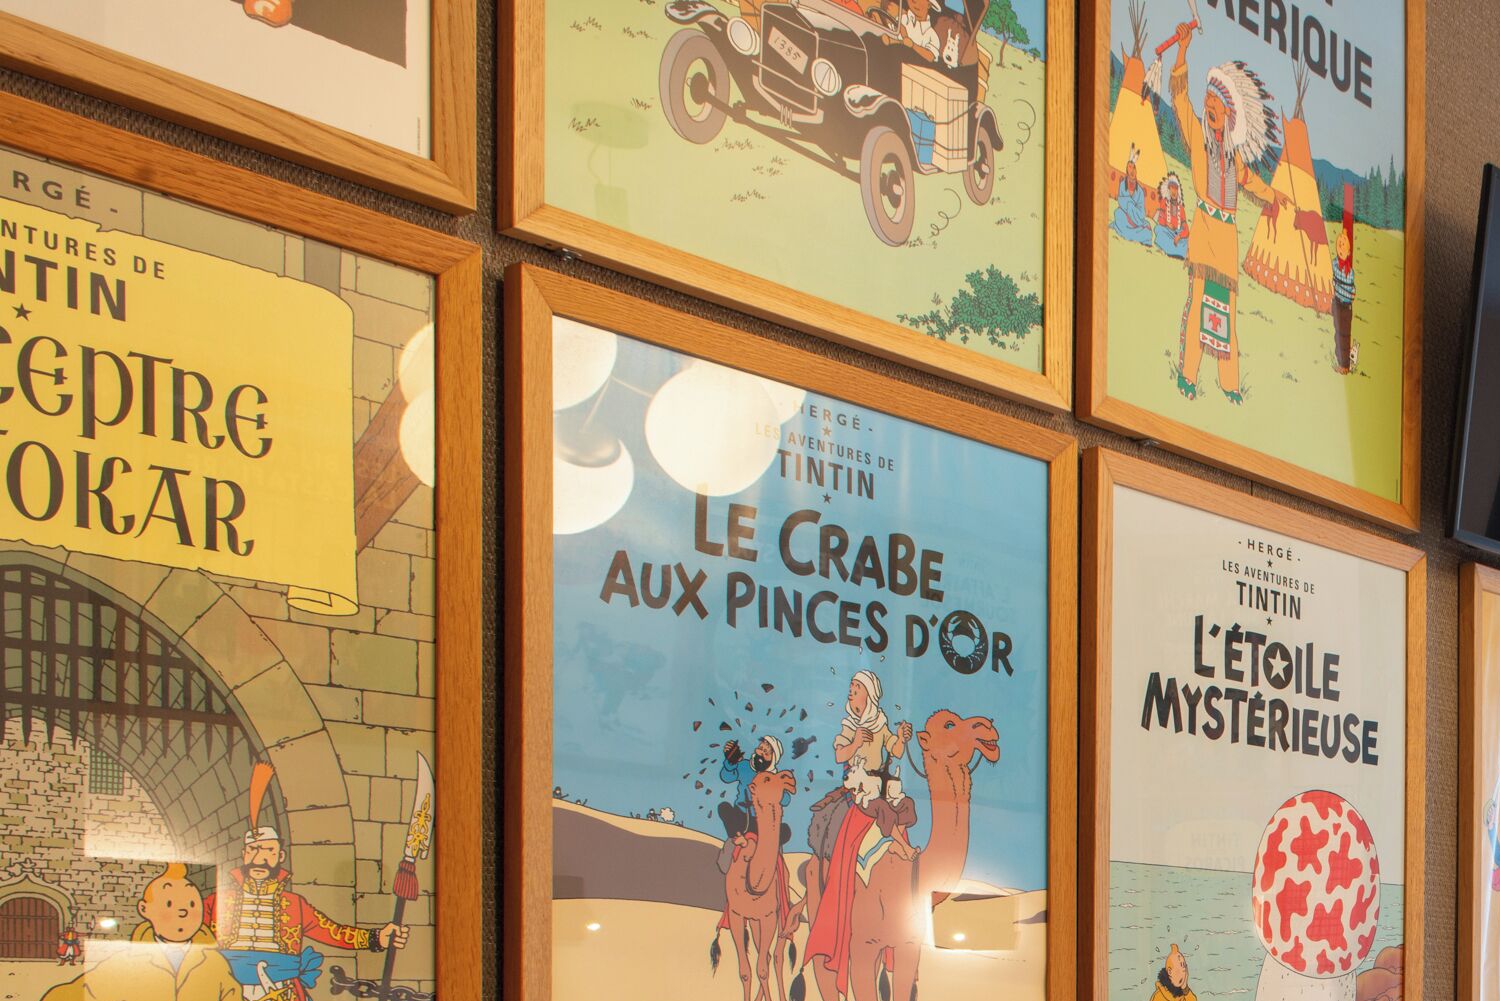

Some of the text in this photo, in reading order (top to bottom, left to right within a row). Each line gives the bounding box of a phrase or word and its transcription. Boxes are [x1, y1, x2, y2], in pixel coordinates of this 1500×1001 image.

[133, 254, 166, 280] DE
[0, 325, 272, 459] EPTRE
[777, 448, 875, 501] TINTIN
[787, 431, 872, 465] AVENTURES
[878, 455, 894, 471] DE
[0, 430, 255, 557] OKAR
[694, 482, 759, 562] LE
[778, 509, 945, 602] CRABE
[1222, 560, 1315, 594] LES AVENTURES DE
[1247, 538, 1293, 561] HERGÉ
[599, 550, 709, 621] AUX
[726, 571, 889, 653] PINCES
[906, 609, 1015, 677] D'OR
[1236, 580, 1301, 620] TINTIN
[1194, 614, 1340, 702] L'ÉTOILE
[1140, 671, 1379, 766] MYSTÉRIEUSE
